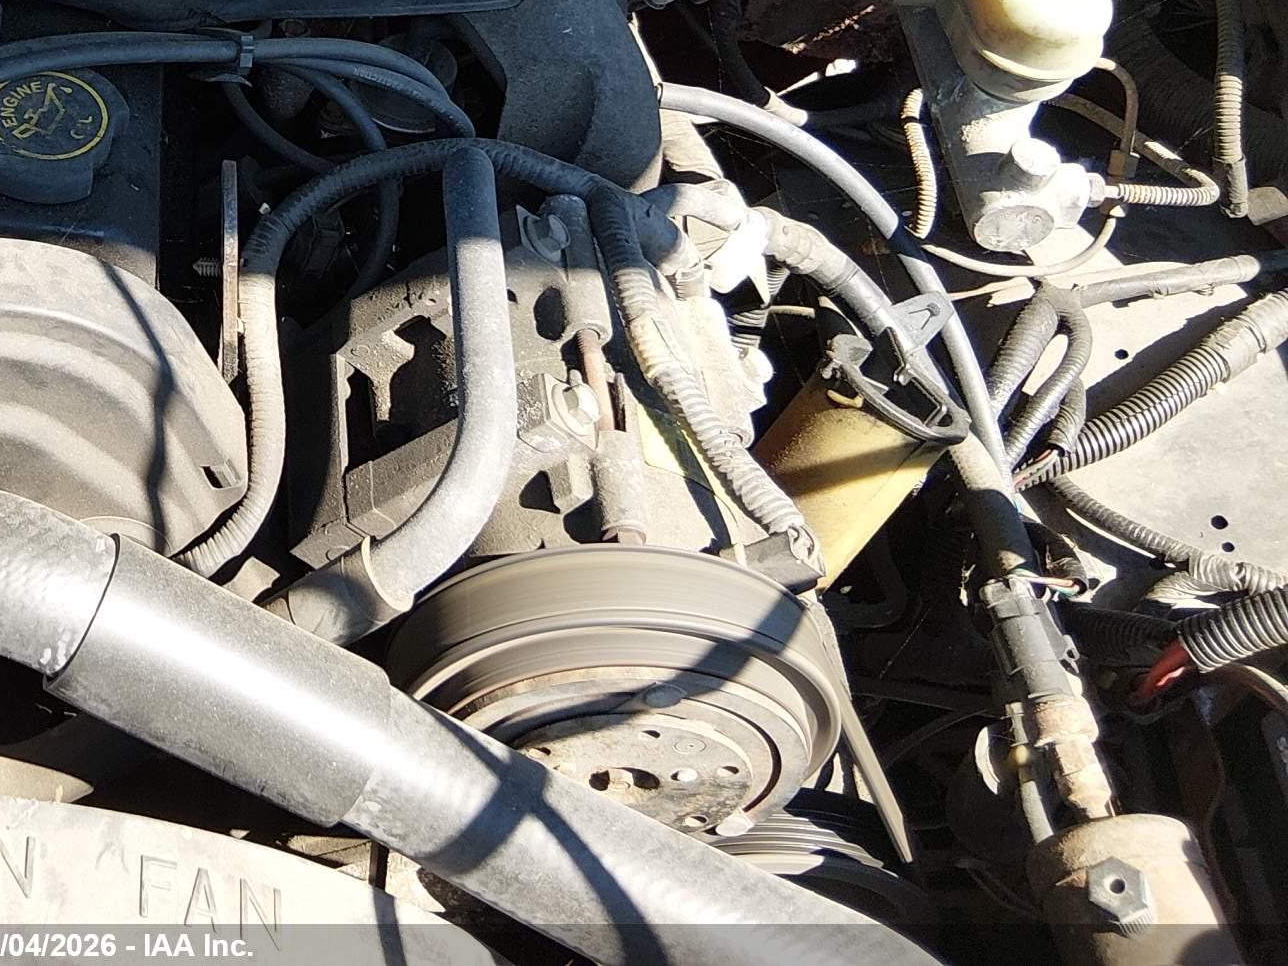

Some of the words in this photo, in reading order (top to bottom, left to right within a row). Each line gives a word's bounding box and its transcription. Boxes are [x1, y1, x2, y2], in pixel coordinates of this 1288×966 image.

[0, 81, 44, 128] ENGINE
[70, 115, 92, 139] OL
[139, 855, 281, 951] FAN
